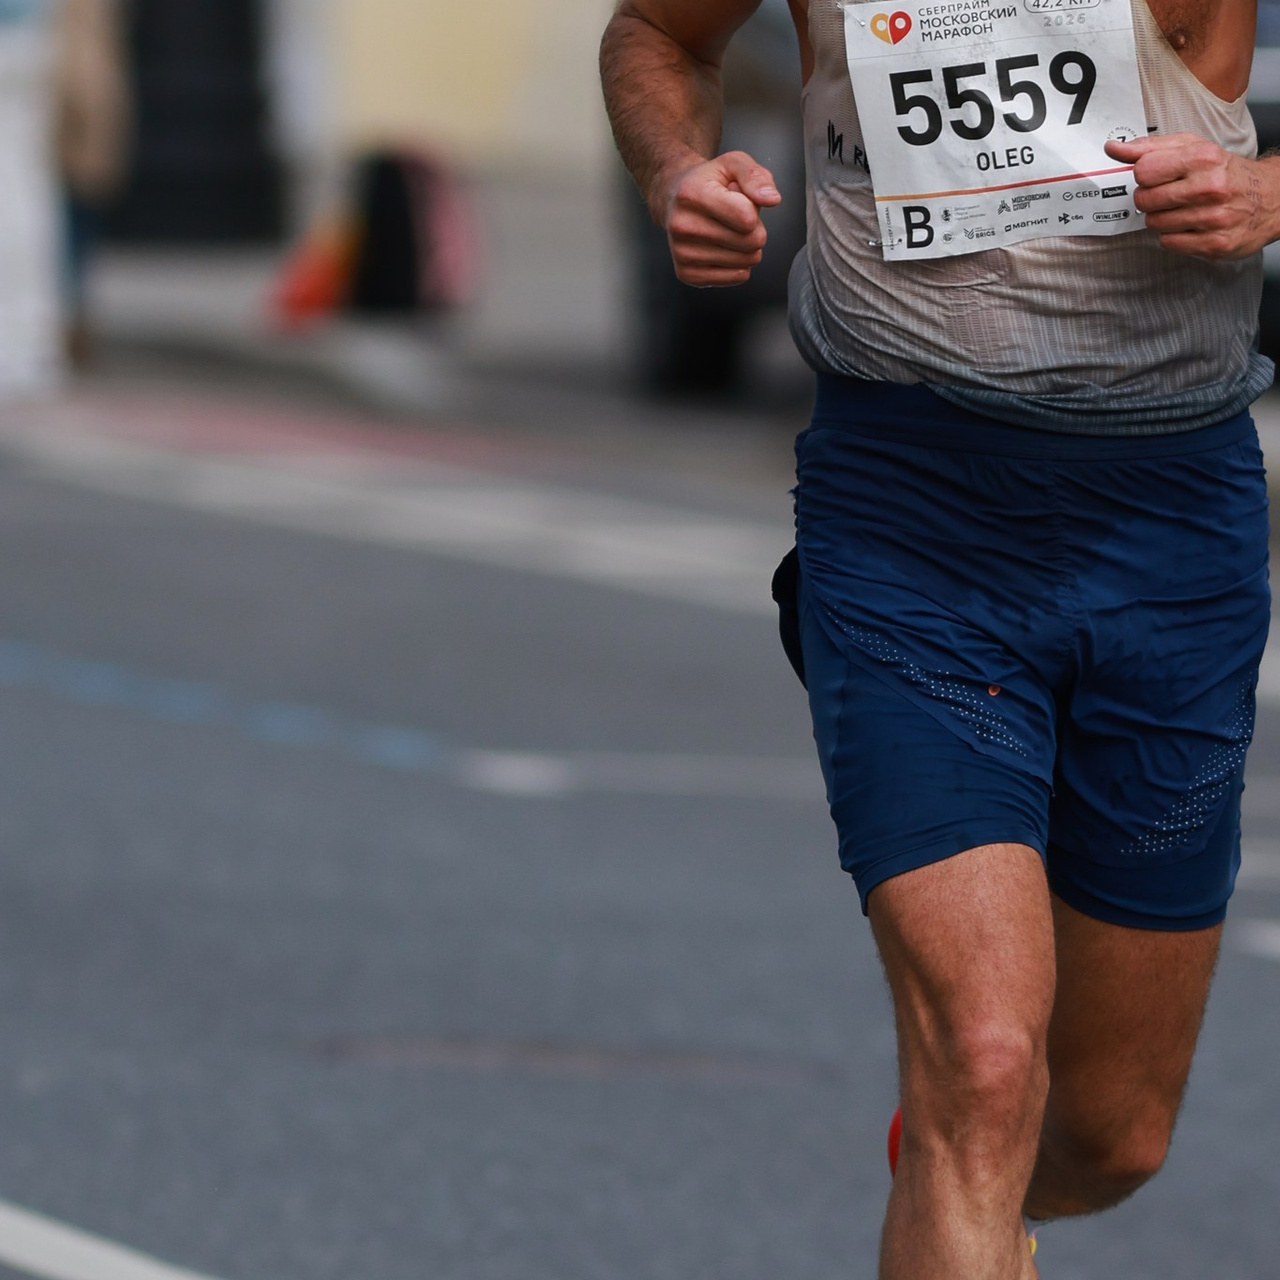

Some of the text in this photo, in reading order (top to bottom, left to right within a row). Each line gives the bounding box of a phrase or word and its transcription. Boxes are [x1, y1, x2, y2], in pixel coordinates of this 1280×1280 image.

[920, 3, 1018, 30] МОСКОВСКИЙ
[921, 23, 994, 43] МАРАФОН
[889, 50, 1097, 147] 5559
[976, 145, 1035, 172] OLEG
[1075, 190, 1100, 198] СБЕР
[902, 205, 935, 249] B
[1095, 212, 1122, 220] WINLINE
